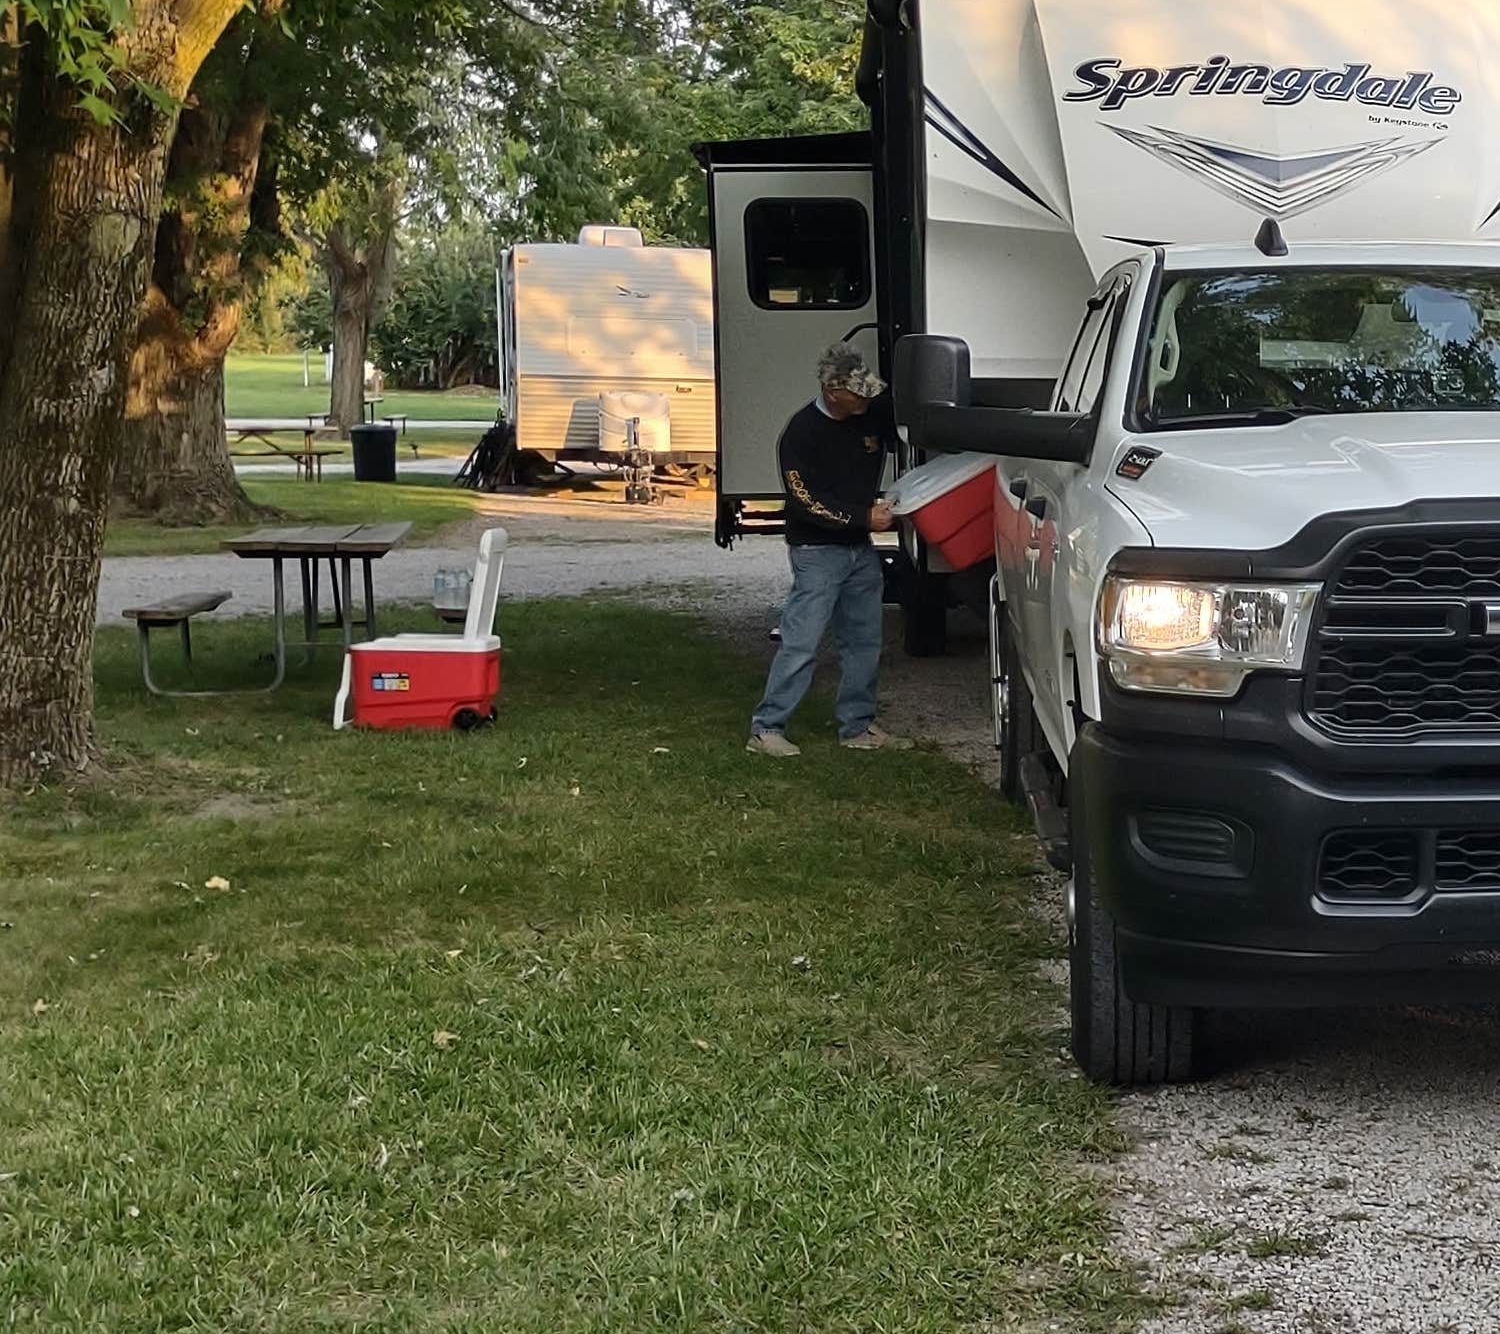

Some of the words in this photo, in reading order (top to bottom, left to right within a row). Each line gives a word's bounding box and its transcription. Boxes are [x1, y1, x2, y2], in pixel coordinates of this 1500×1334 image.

[1062, 53, 1462, 115] Springdale
[1368, 115, 1381, 123] by
[1384, 117, 1430, 127] Keystone
